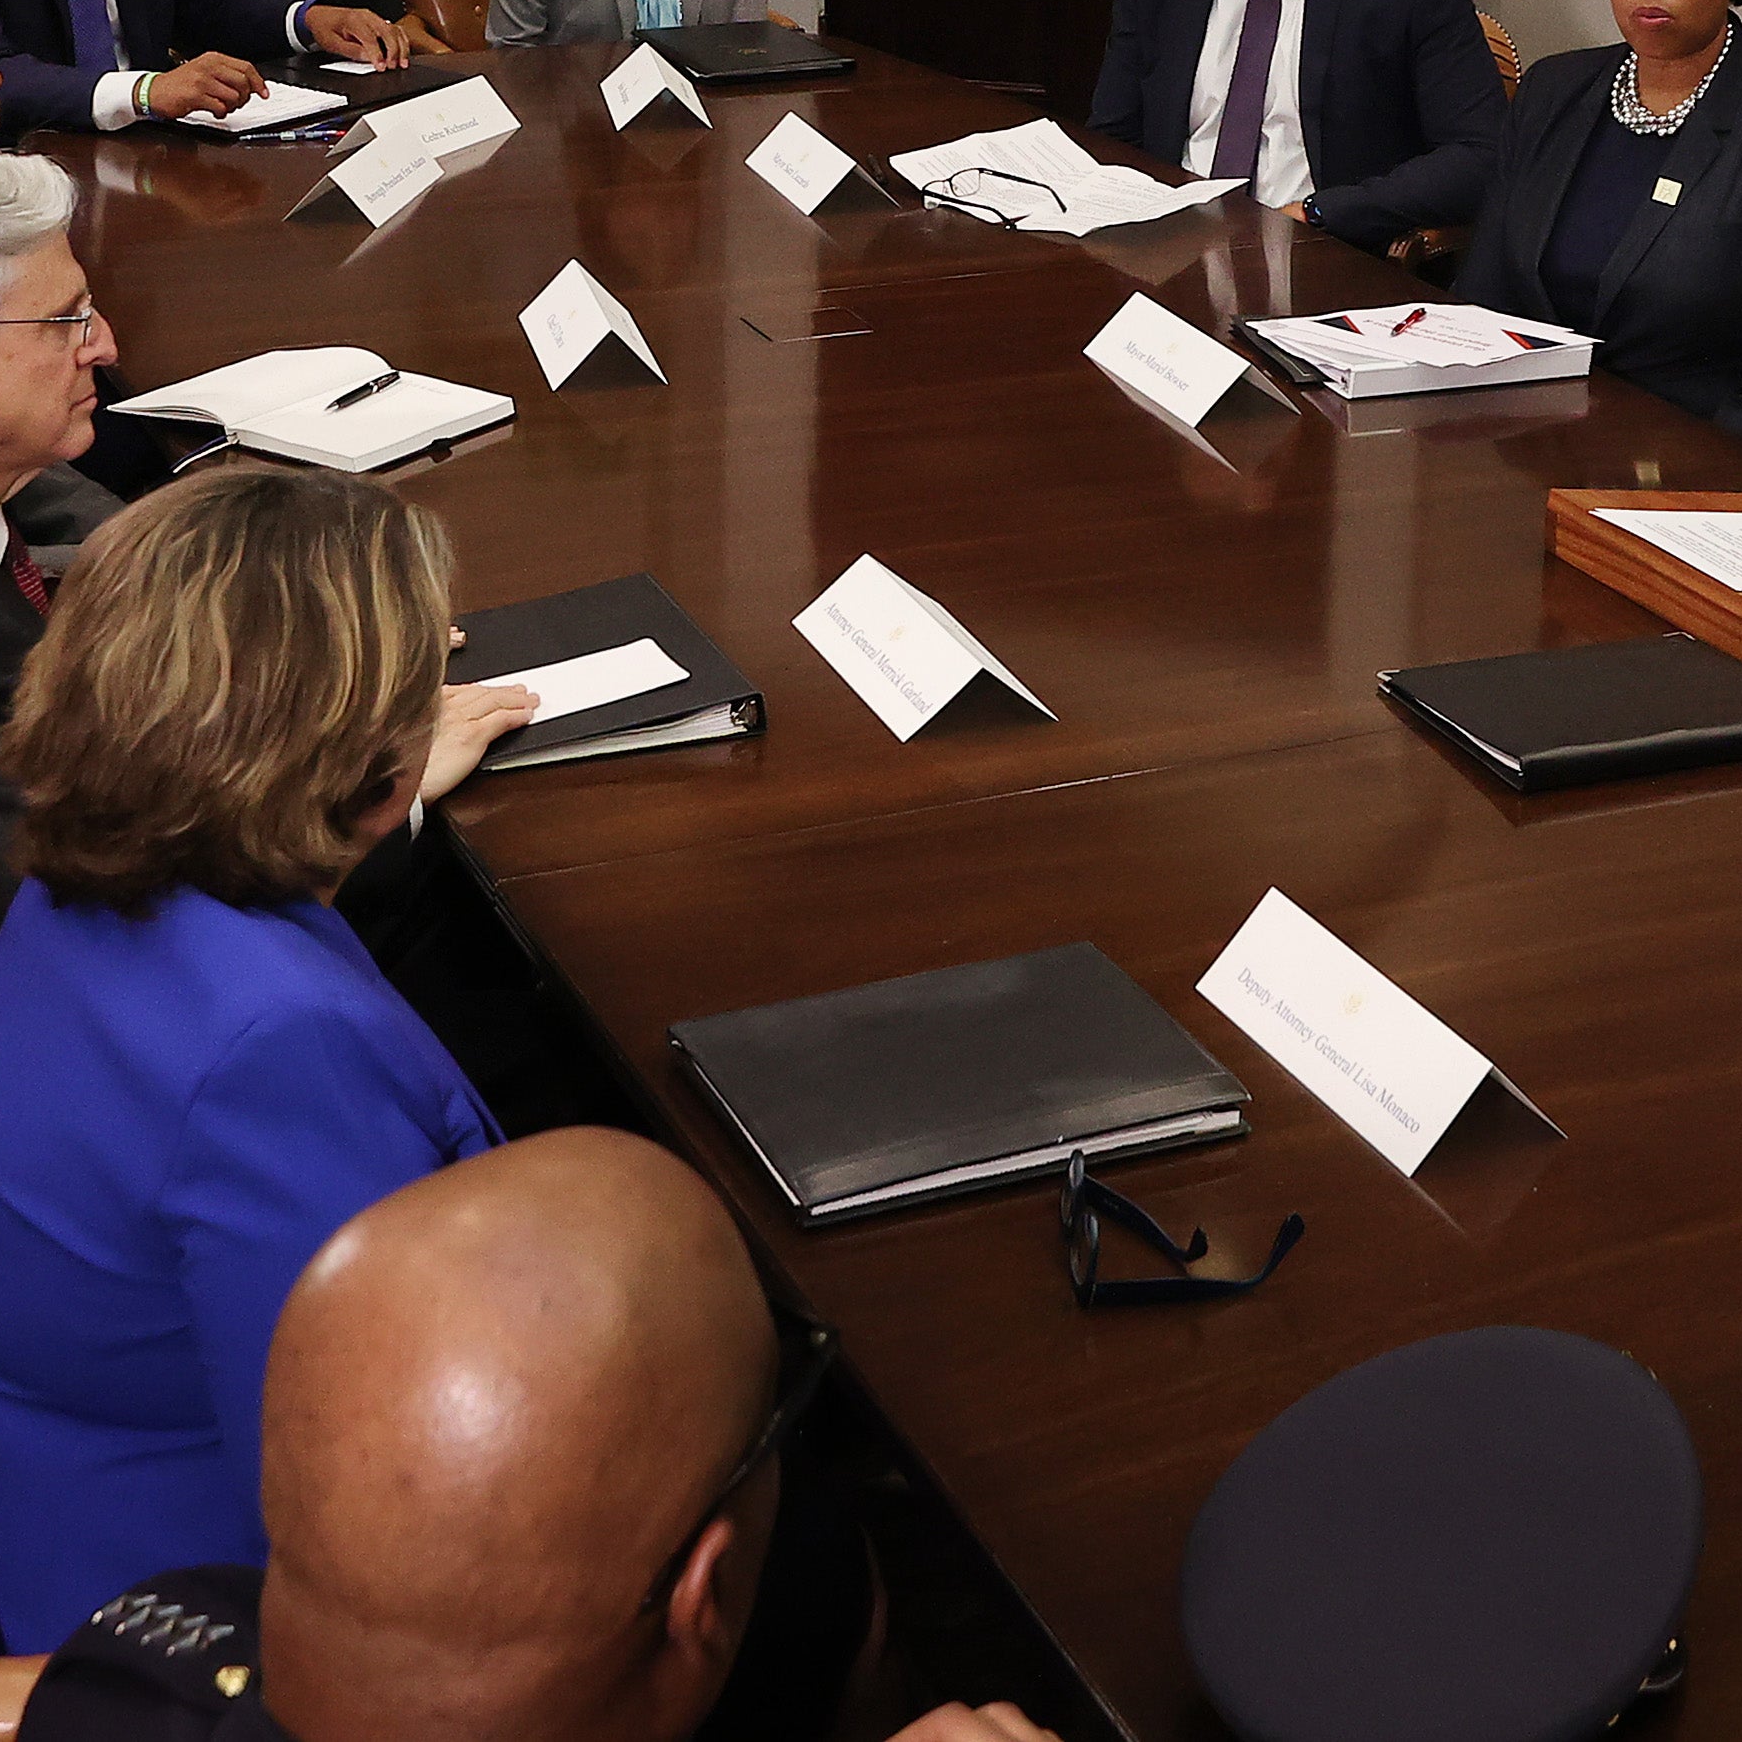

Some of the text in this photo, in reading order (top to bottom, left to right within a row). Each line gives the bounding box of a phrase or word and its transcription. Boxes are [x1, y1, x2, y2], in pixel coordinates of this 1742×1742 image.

[850, 627, 883, 661] General
[1237, 966, 1422, 1135] Deputy Attorney General Lisa Monaco
